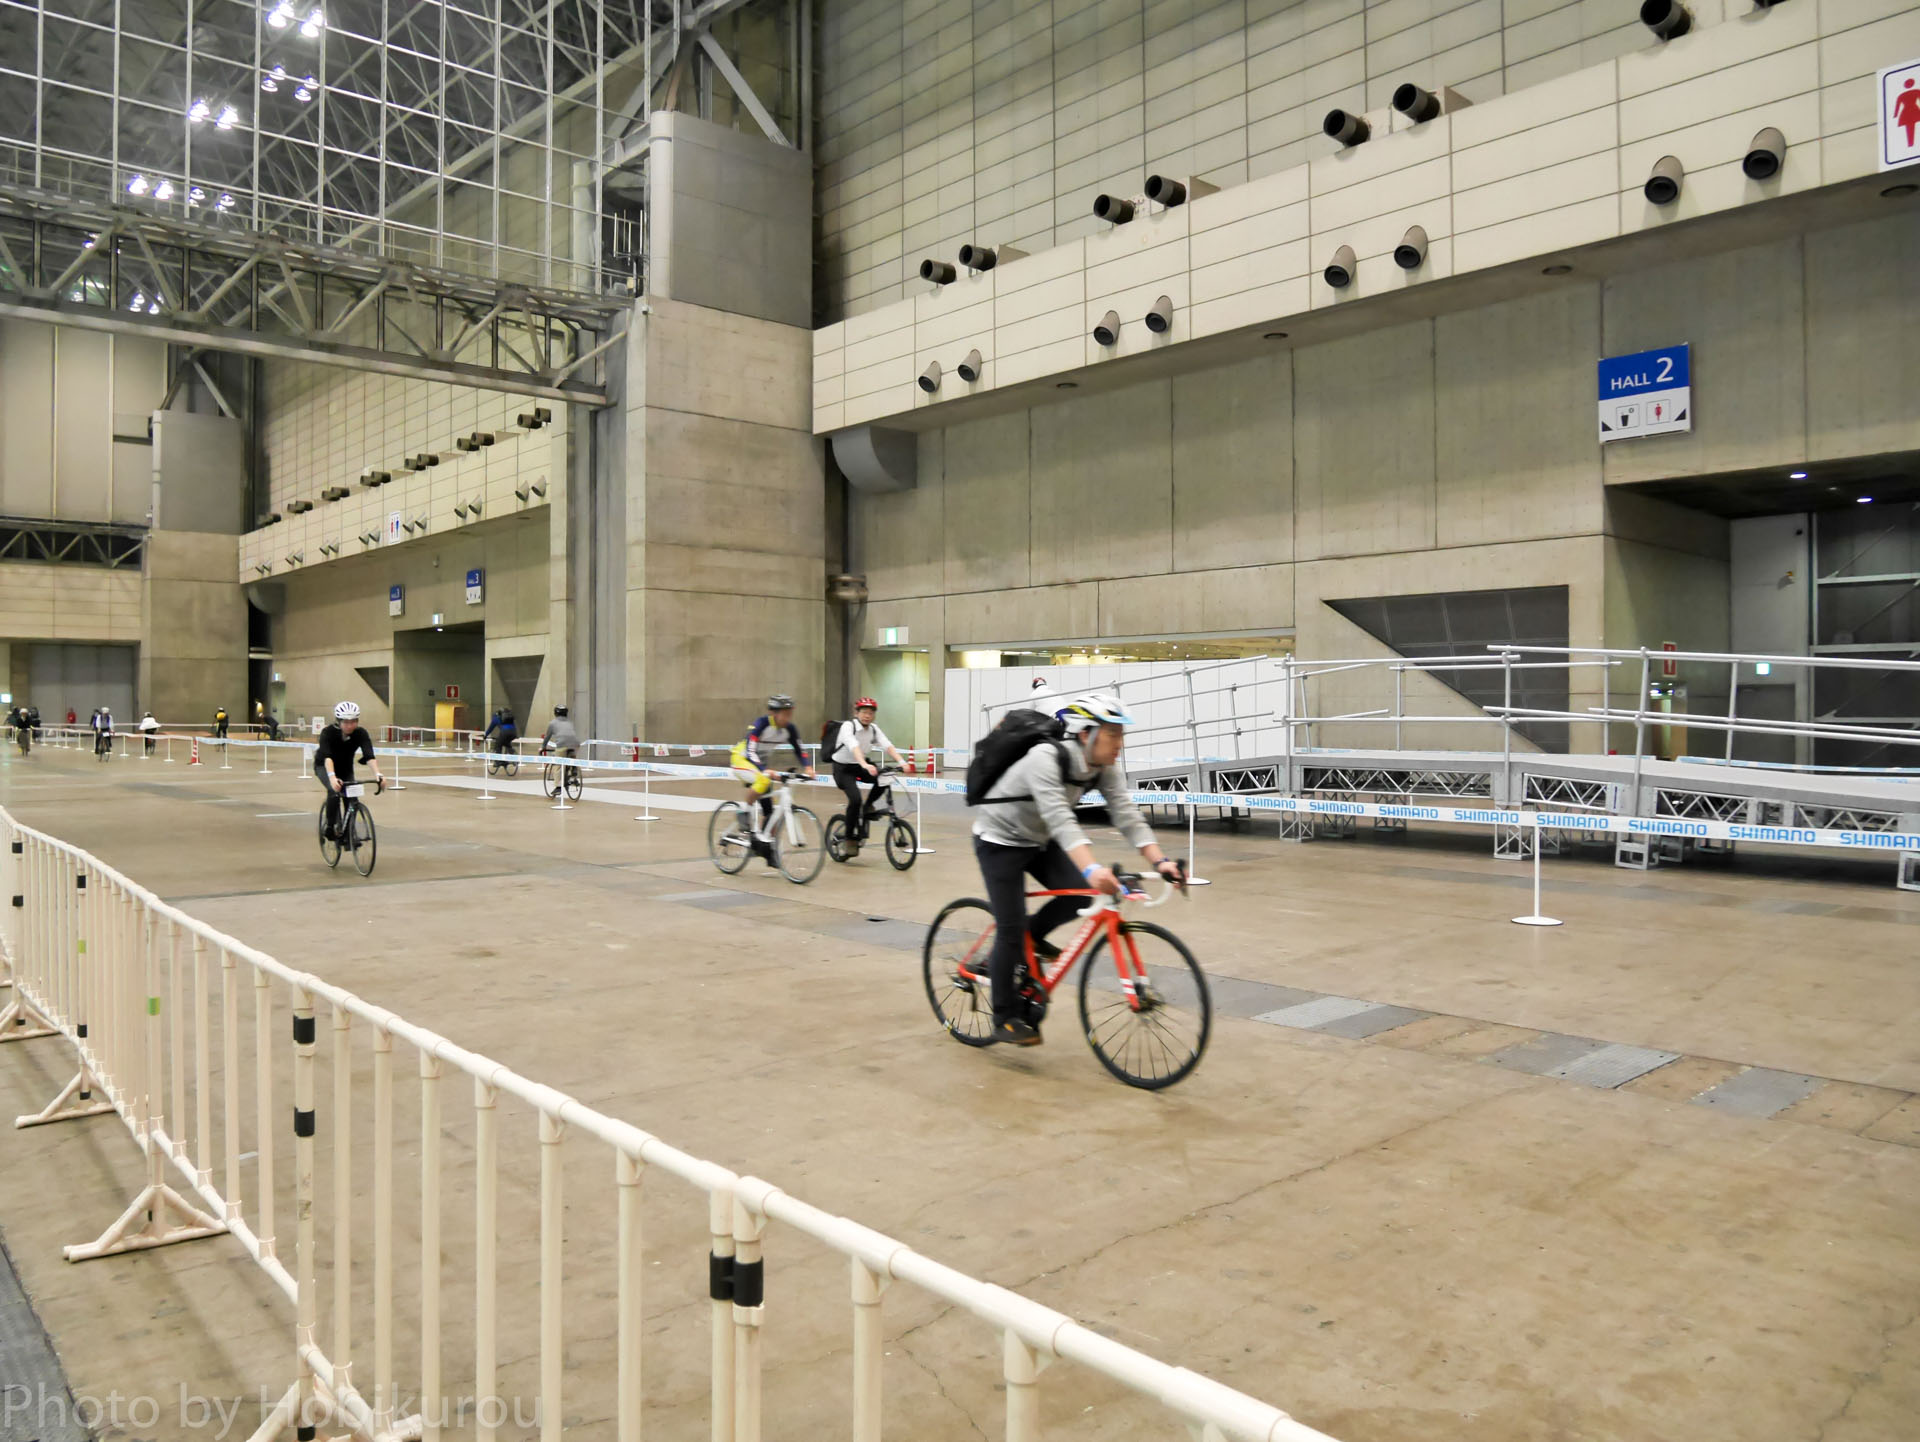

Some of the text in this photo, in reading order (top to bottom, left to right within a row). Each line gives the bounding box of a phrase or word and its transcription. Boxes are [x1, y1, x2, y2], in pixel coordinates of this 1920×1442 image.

[1610, 357, 1674, 391] HALL 2
[906, 779, 938, 789] SHIMANO
[1132, 794, 1178, 803] SHIMANO
[1185, 794, 1233, 806] SHIMANO
[1245, 796, 1296, 809] SHIMANO
[1309, 801, 1365, 815] SHIMANO
[1378, 806, 1439, 819] SHIMANO
[1454, 810, 1520, 824] SHIMANO
[1536, 813, 1609, 829] SHIMANO
[1628, 819, 1708, 836] SHIMANO
[1727, 826, 1816, 843] SHIMANO
